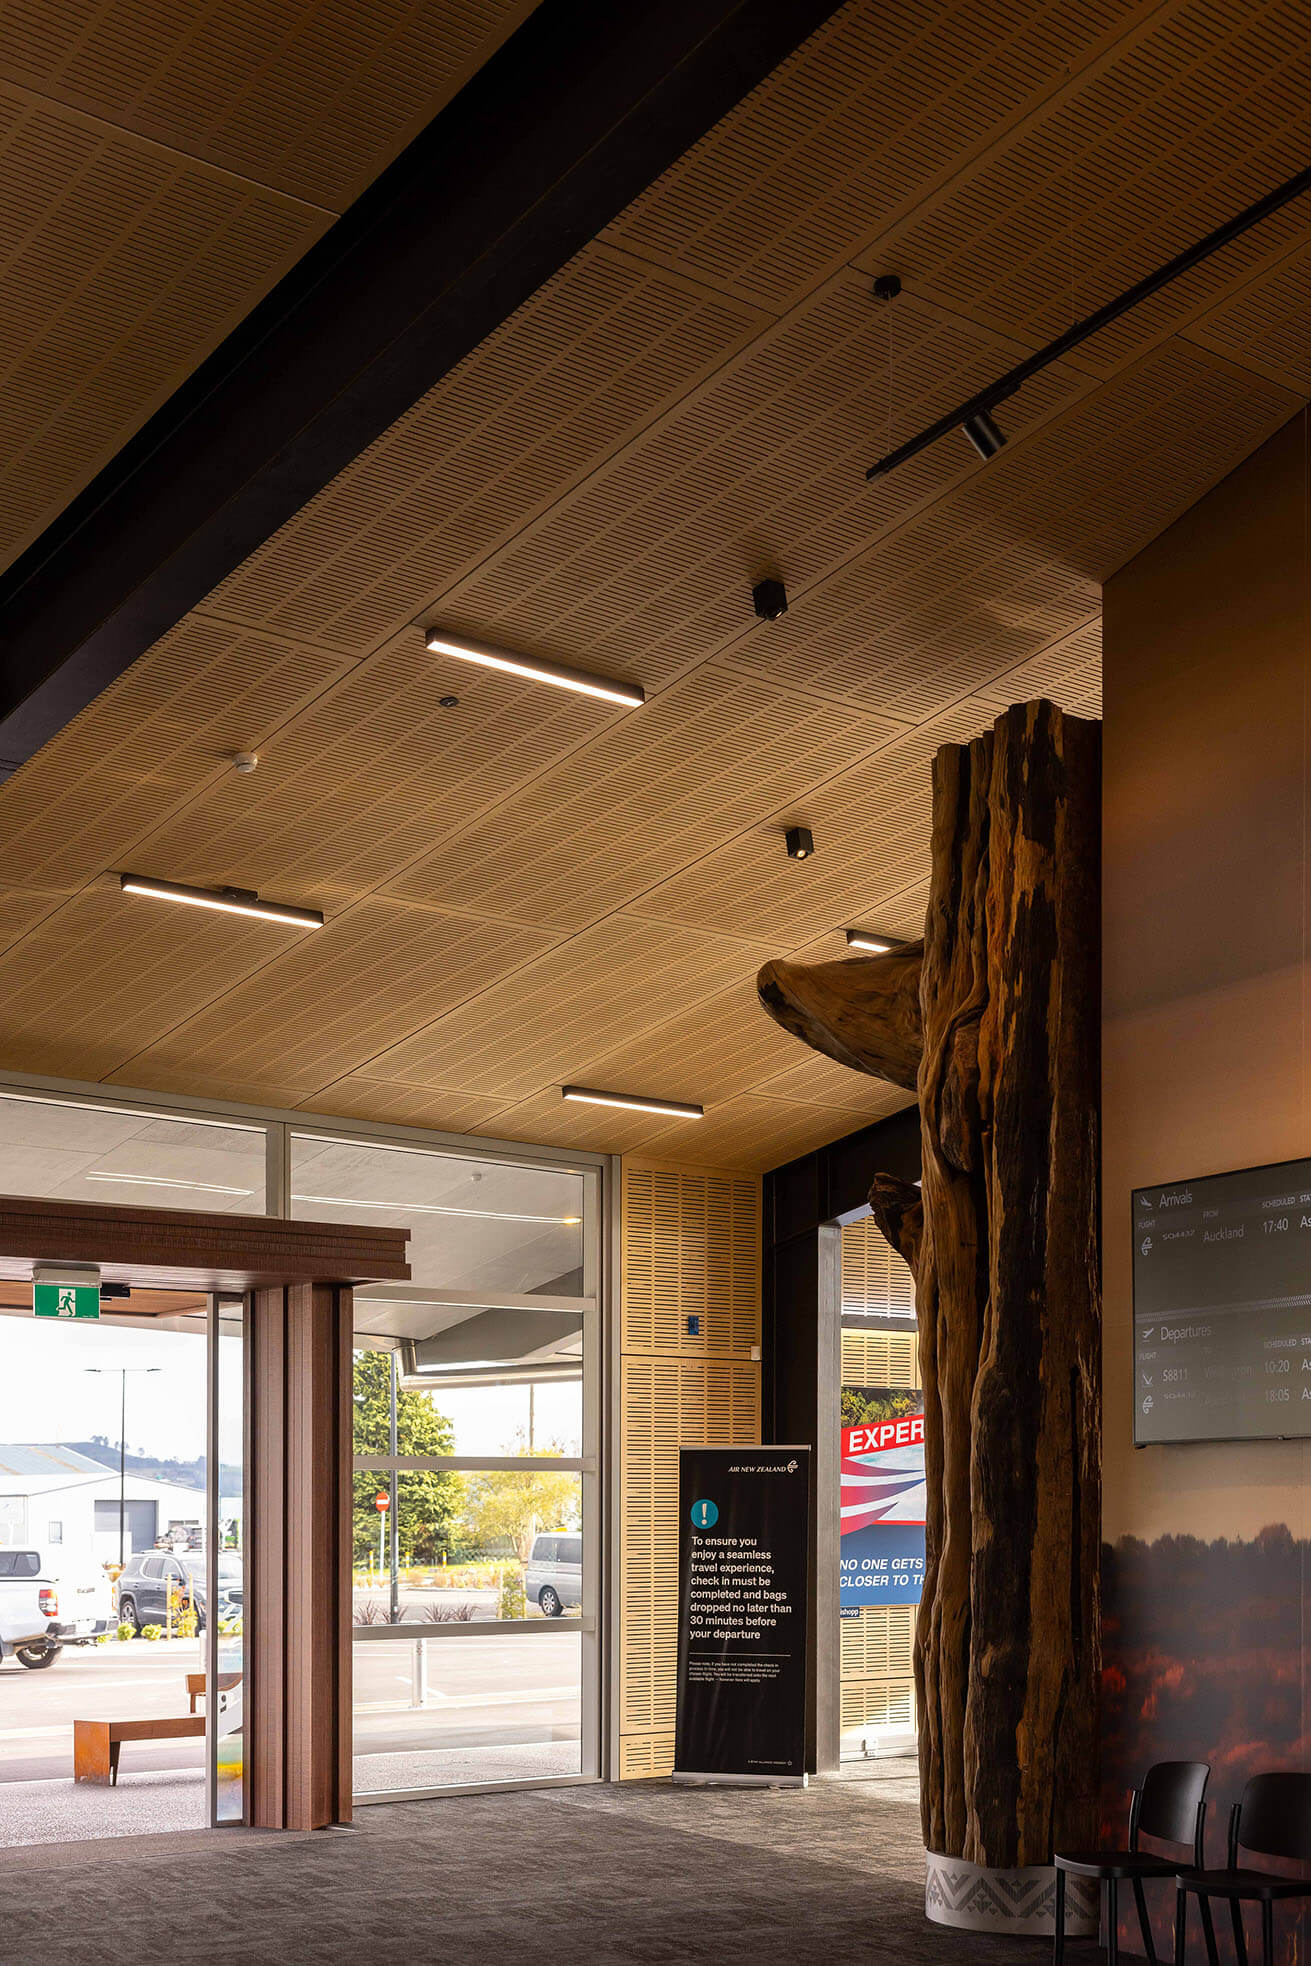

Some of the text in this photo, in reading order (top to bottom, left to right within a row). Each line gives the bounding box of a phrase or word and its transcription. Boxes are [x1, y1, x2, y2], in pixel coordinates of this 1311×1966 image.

[1159, 1188, 1193, 1208] Arrivals
[1262, 1196, 1295, 1209] SCHEDULED
[1203, 1225, 1245, 1242] Auckland
[1263, 1218, 1289, 1233] 17:40
[1160, 1325, 1212, 1343] Departures
[1264, 1360, 1290, 1373] 10:20
[1265, 1388, 1290, 1403] 18:05
[849, 1419, 924, 1453] EXPER
[692, 1536, 757, 1548] To ensure you
[691, 1550, 716, 1560] enjoy
[726, 1550, 772, 1560] seamless
[691, 1563, 774, 1574] travel experience,
[840, 1558, 924, 1571] NO ONE GETS
[690, 1576, 771, 1586] check in must be
[840, 1575, 889, 1587] CLOSER
[893, 1574, 909, 1586] TO
[690, 1590, 787, 1601] completed and bags
[690, 1603, 792, 1613] dropped no later than
[690, 1616, 777, 1626] 30 minutes before
[689, 1629, 760, 1640] your departure
